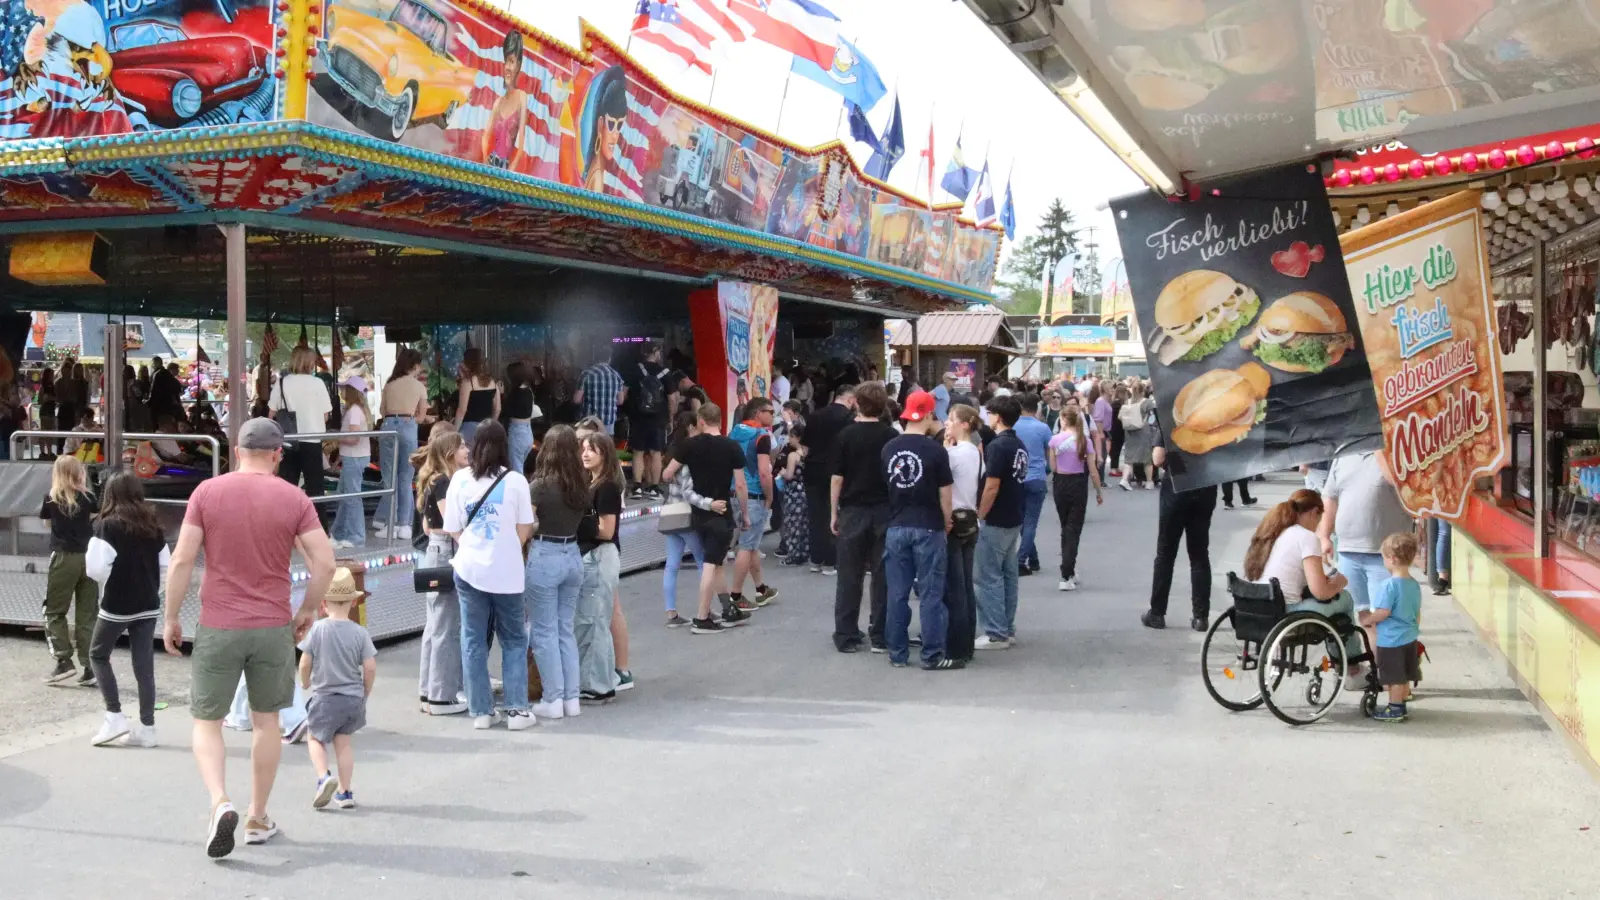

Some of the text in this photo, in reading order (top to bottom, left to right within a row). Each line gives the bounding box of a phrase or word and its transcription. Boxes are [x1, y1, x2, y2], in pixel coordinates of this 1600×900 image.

[1145, 212, 1225, 260] Fisch
[1363, 243, 1455, 311] Hier die
[729, 318, 747, 337] ROUTE
[732, 334, 747, 364] 66
[1392, 298, 1451, 356] frisch
[1385, 339, 1475, 409] gebrannten
[1393, 387, 1486, 477] Mandeln
